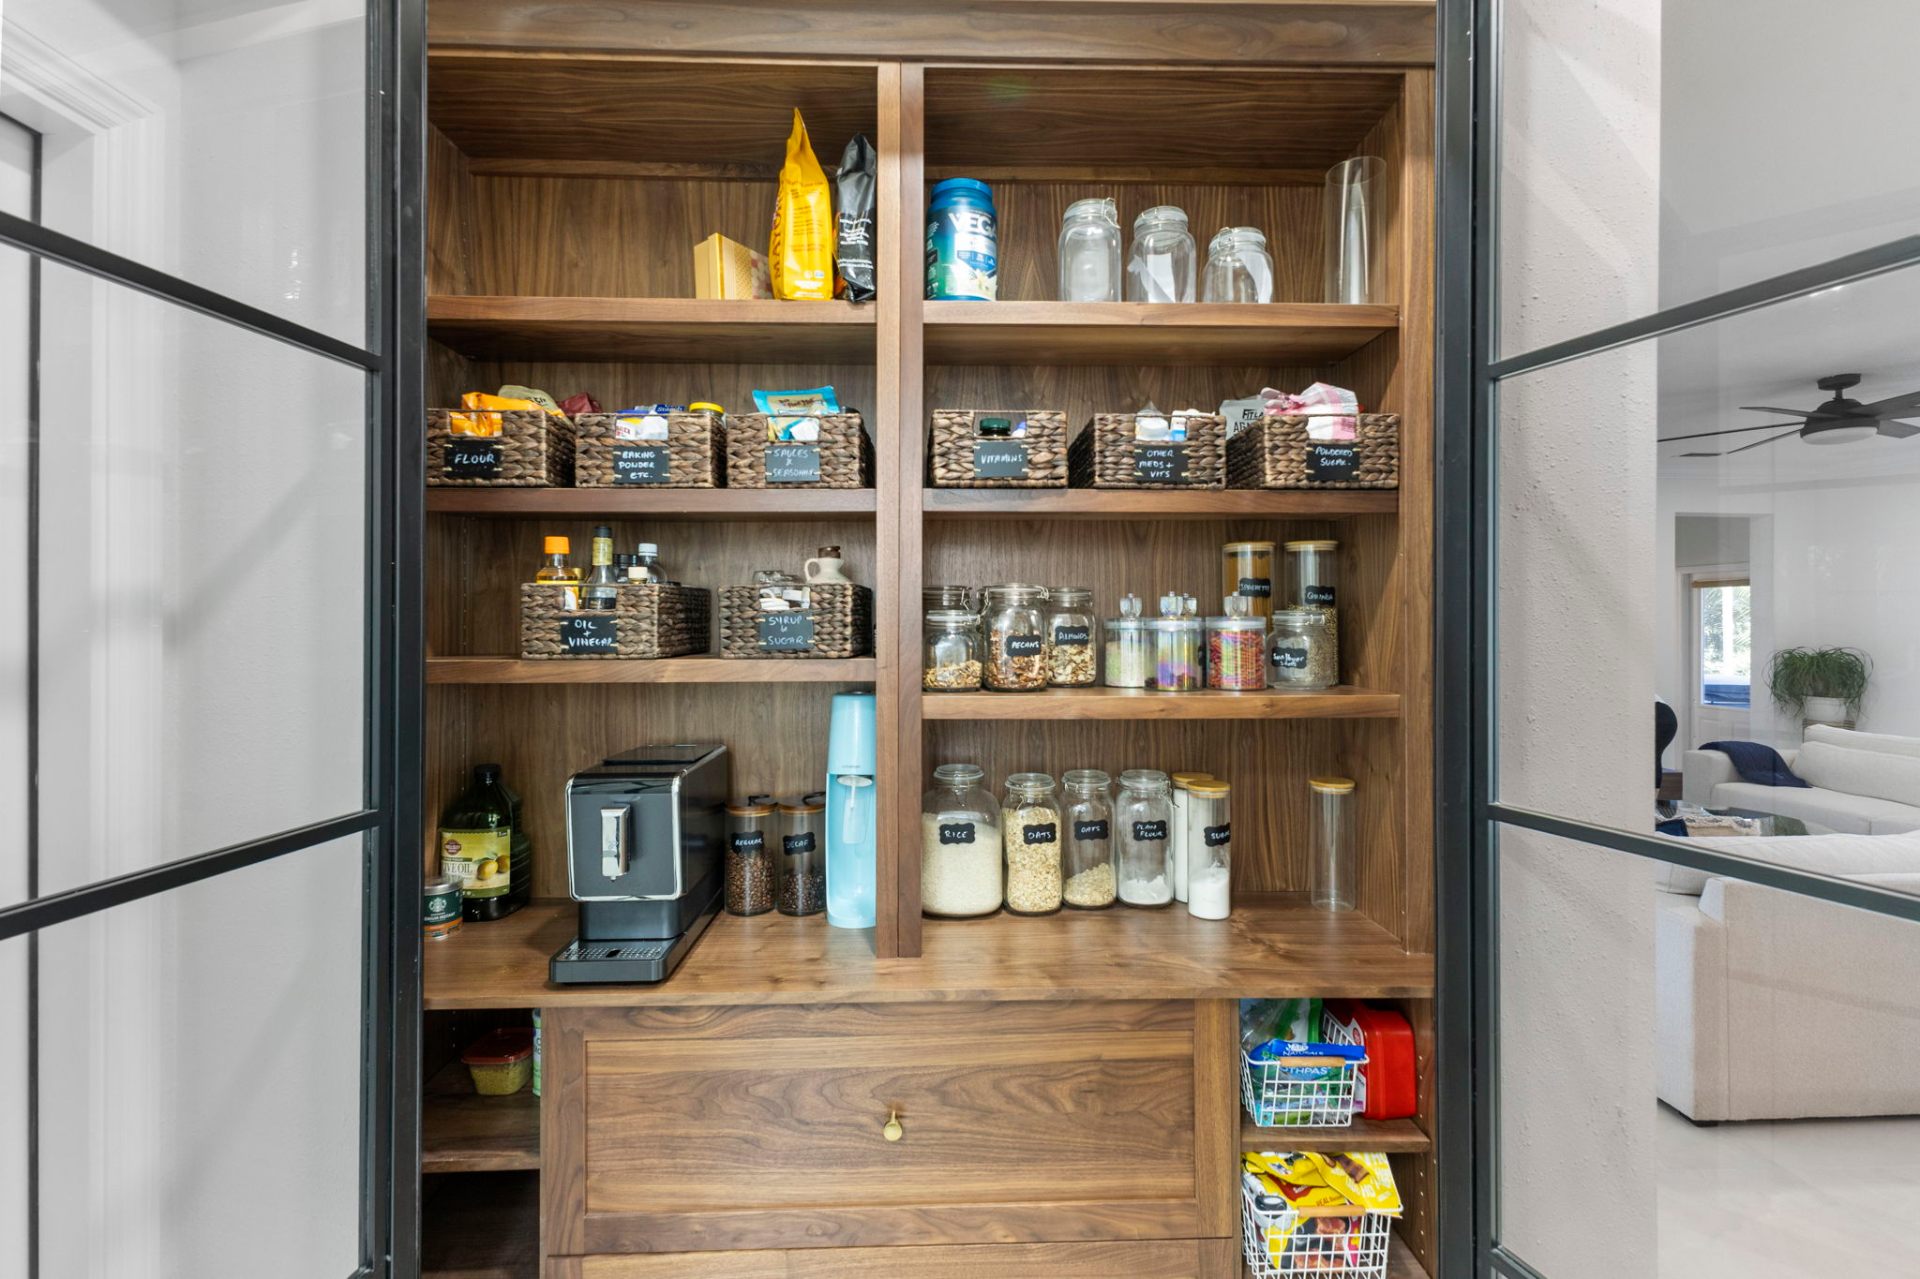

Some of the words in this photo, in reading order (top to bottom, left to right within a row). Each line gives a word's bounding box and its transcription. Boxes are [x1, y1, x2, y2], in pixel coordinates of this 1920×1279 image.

[622, 450, 656, 459] BAKING
[773, 448, 809, 459] SAUCES
[1146, 449, 1175, 458] OTHER
[1315, 446, 1353, 457] POWDERED
[454, 453, 496, 464] FLOUR
[980, 453, 1023, 464] VITAMINS
[618, 461, 655, 470] POWDER
[1139, 460, 1165, 469] MEDS
[1150, 470, 1171, 478] VITS
[574, 619, 599, 630] OIL
[768, 614, 803, 626] SYRUP
[583, 630, 592, 638] +
[1058, 631, 1088, 641] ALMONDS
[568, 636, 612, 648] VINEGAR
[767, 635, 804, 646] SUGAR
[1011, 641, 1040, 649] PECANS
[1080, 825, 1102, 833] OATS
[944, 830, 969, 839] RICE
[1027, 831, 1053, 840] OATS
